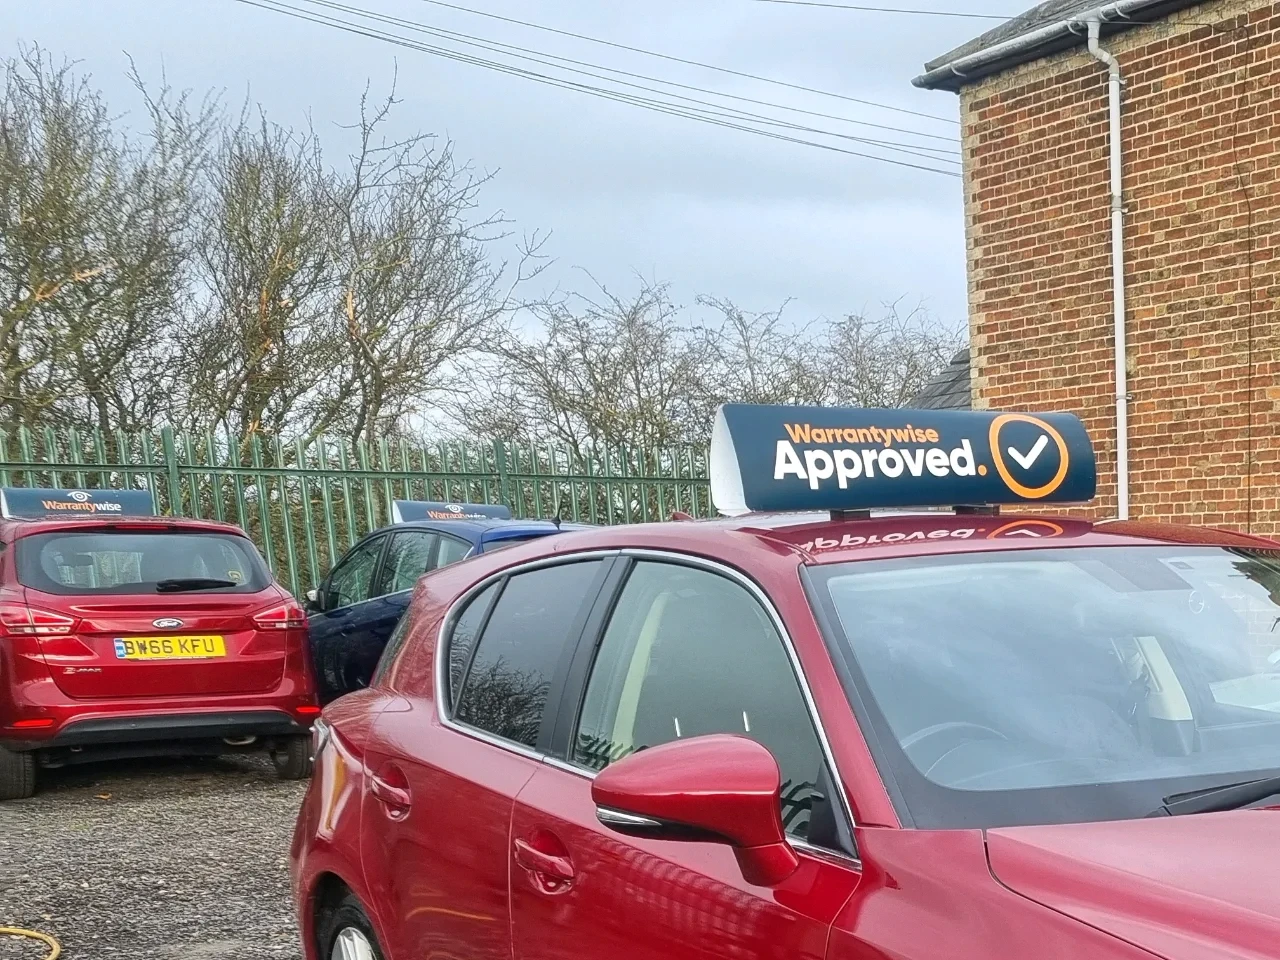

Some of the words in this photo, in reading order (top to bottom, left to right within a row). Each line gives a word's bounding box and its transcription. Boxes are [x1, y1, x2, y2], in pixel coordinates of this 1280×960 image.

[784, 423, 939, 448] Warrantywise
[773, 438, 987, 490] Approved.
[42, 500, 122, 513] Warrantywise
[124, 639, 174, 655] BW66
[179, 638, 215, 654] KFU
